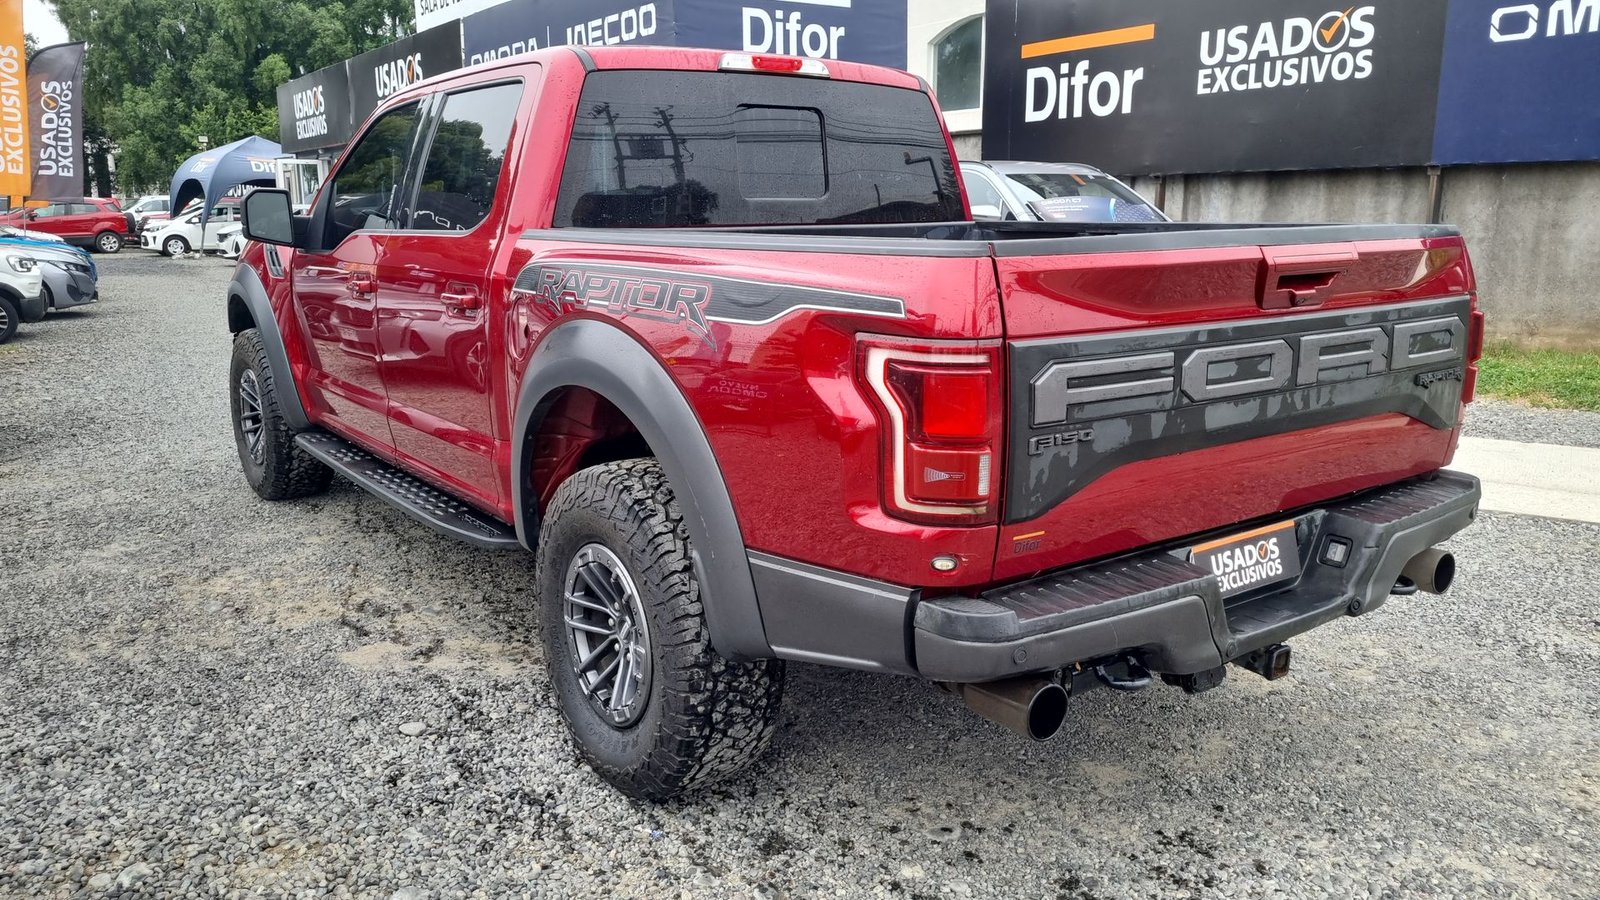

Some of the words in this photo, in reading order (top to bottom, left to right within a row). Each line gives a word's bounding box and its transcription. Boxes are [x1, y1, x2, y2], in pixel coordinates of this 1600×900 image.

[741, 7, 845, 59] Difor
[1199, 5, 1376, 66] USADOS
[374, 52, 424, 98] USADOS
[1025, 60, 1145, 123] Difor
[1196, 48, 1374, 95] EXCLUSIVOS
[0, 45, 24, 175] EXCLUSIVOS
[38, 80, 61, 176] USADOS
[293, 84, 326, 120] USADOS
[57, 80, 74, 177] EXCLUSIVOS
[250, 160, 276, 174] Dif
[537, 266, 717, 352] RAPTOR
[1029, 315, 1466, 428] FORD
[1414, 367, 1463, 389] RAPTOR
[1013, 540, 1042, 554] Difor
[1210, 537, 1280, 576] USADOS
